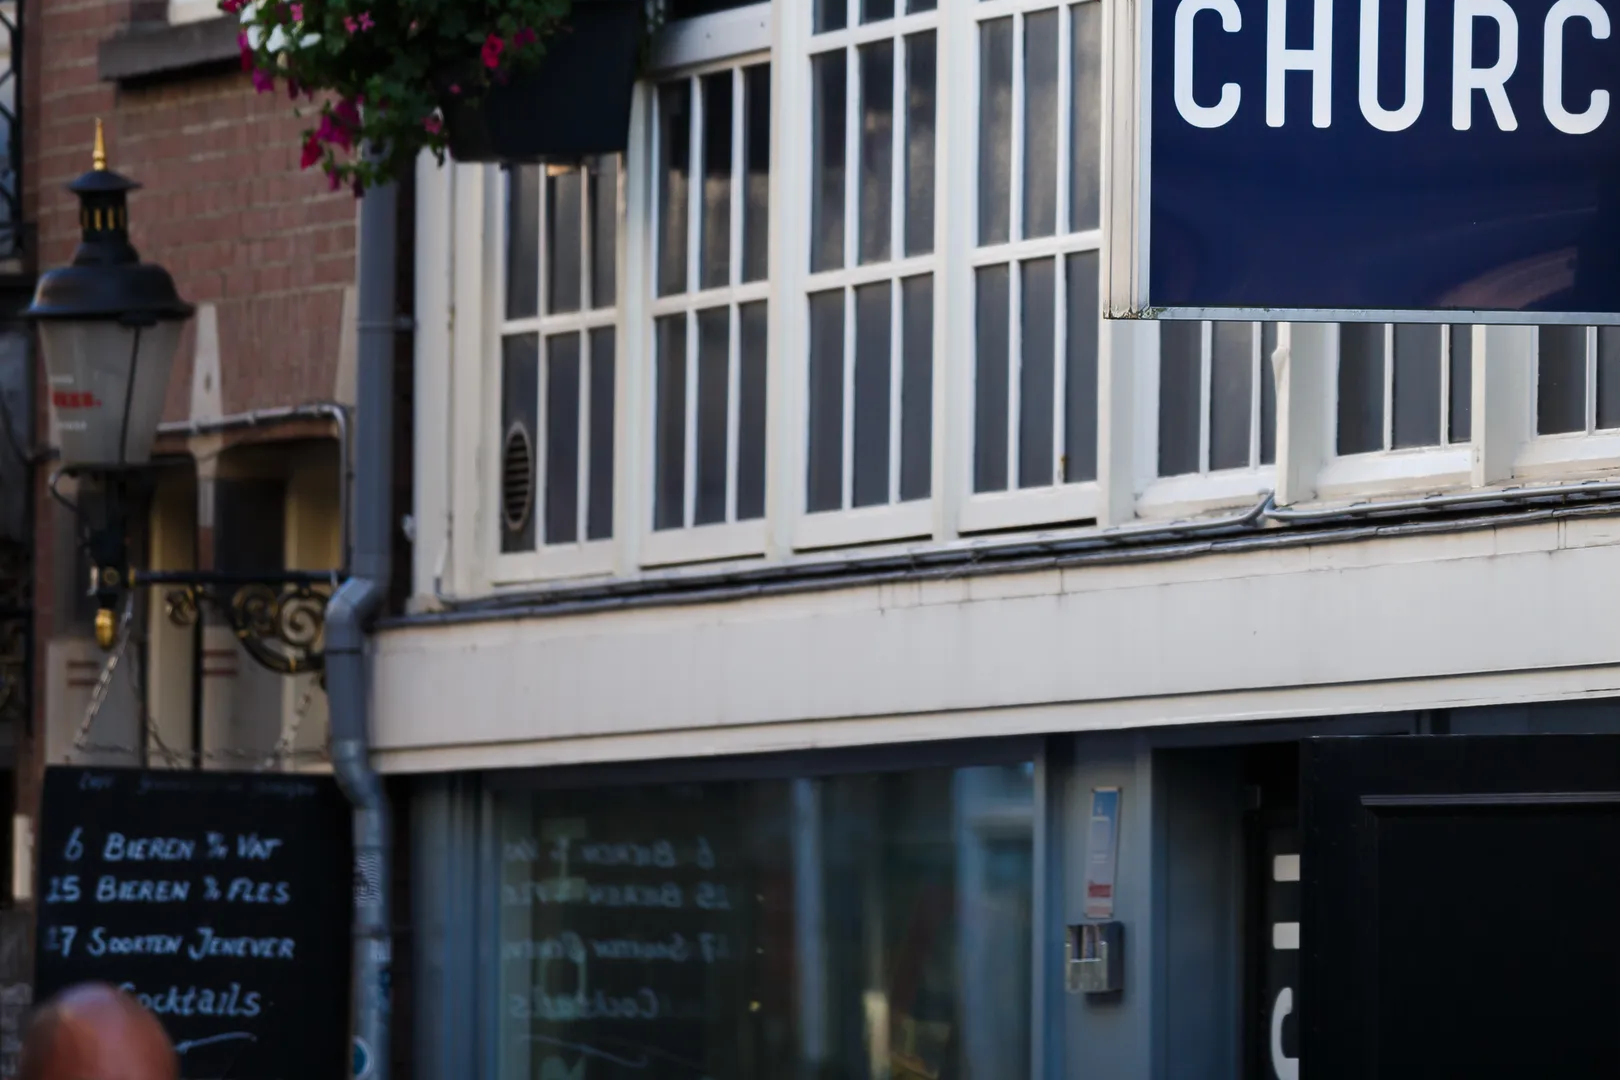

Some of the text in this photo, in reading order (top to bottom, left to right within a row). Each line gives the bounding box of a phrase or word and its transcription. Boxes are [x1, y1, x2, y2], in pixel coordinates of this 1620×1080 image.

[65, 827, 83, 862] 6
[104, 832, 196, 862] BIEREN
[96, 875, 190, 903] BIEREN
[227, 877, 291, 905] FLES
